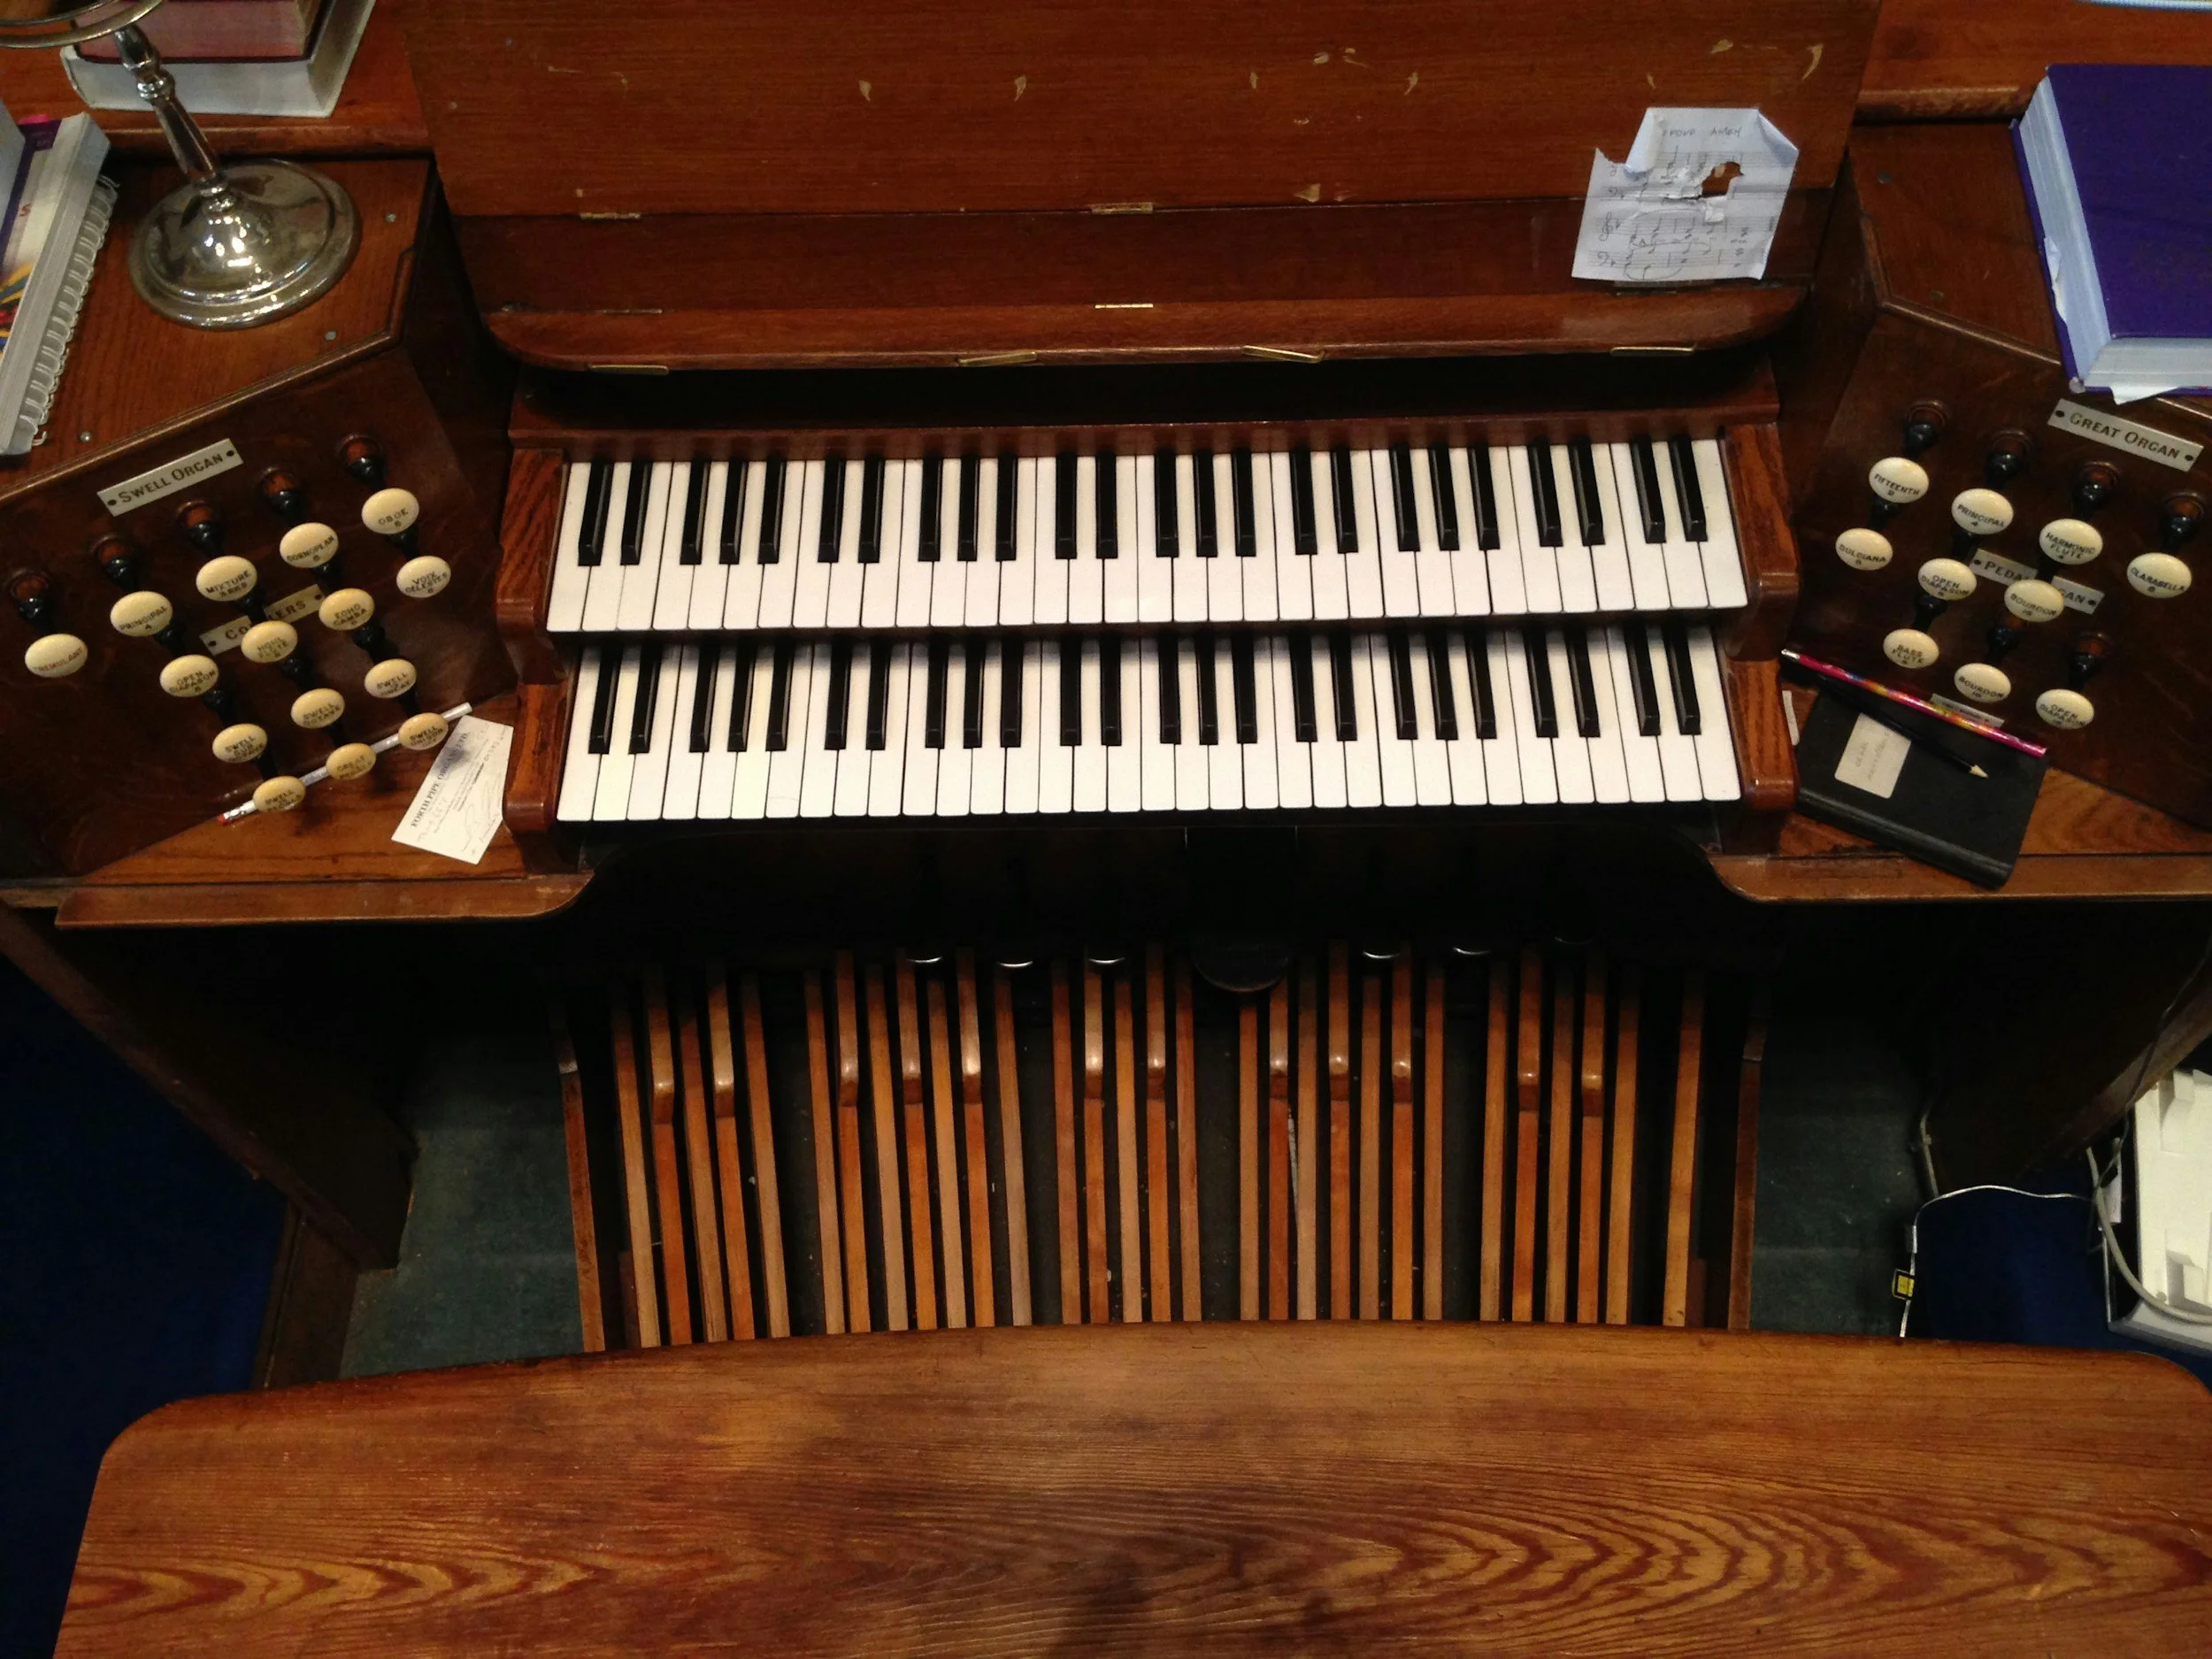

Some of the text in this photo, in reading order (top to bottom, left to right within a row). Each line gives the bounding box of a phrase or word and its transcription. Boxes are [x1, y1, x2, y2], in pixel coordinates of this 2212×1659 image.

[2069, 411, 2181, 460] GREAT ORGAN
[117, 453, 224, 503] SWELL ORGAN
[1873, 473, 1921, 496] FIFTEENTH
[378, 508, 410, 526] OBOE
[1956, 503, 2006, 528] PRINCIPAL
[285, 534, 335, 564] CORNOPEAN
[1838, 543, 1887, 564] DULCIANA
[2045, 532, 2096, 556] HARMONIC
[2050, 542, 2081, 560] FLUTE
[204, 569, 251, 595] MIXTURE
[404, 572, 449, 595] CELESTES
[412, 571, 437, 586] VOIX
[1920, 575, 1970, 596] DIAPASON
[1932, 574, 1961, 589] OPEN
[2130, 567, 2185, 592] CLARABELLA
[334, 603, 361, 620] ECHO
[2008, 593, 2058, 617] BOURDON
[118, 605, 169, 632] PRINCIPAL
[32, 646, 85, 672] TREMULANT
[168, 669, 217, 693] DIAPASON
[176, 671, 204, 687] OPEN
[377, 672, 408, 689] SWELL
[1958, 675, 2006, 698] BOURDON
[2039, 703, 2086, 726] DIAPASON
[2051, 703, 2079, 719] OPEN
[410, 726, 439, 742] SWELL
[411, 799, 431, 828] FORTH
[426, 781, 441, 800] PIPE
